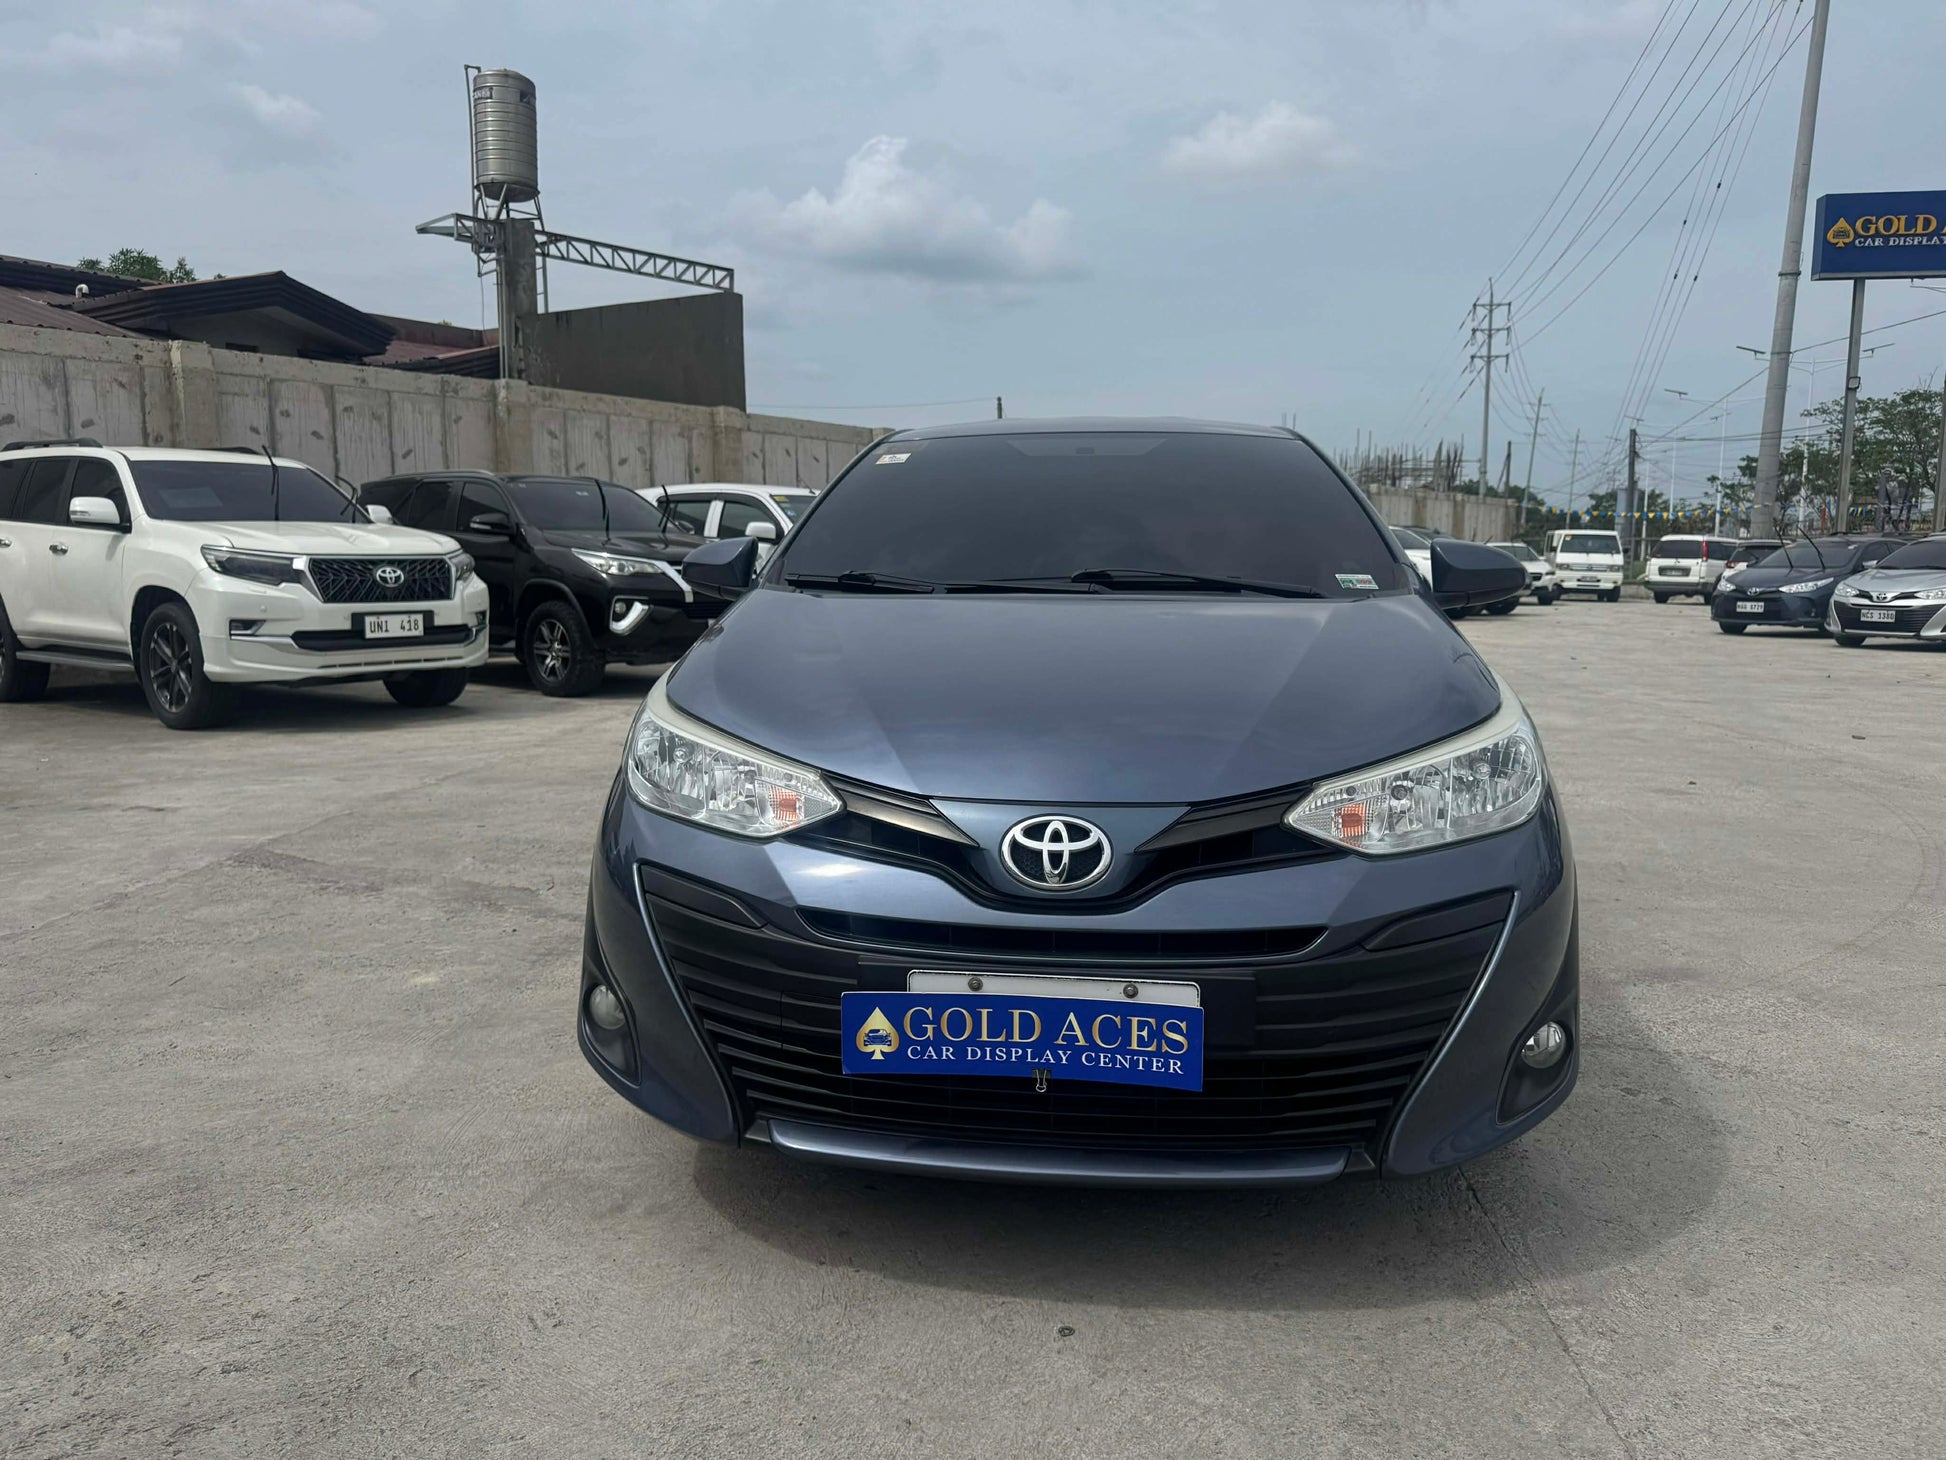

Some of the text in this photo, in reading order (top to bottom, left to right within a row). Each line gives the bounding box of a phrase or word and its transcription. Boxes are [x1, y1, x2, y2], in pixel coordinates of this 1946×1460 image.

[1855, 215, 1937, 236] GOLD
[1855, 237, 1884, 247] CAR
[369, 618, 420, 634] UNI 418
[903, 1006, 1189, 1055] GOLD ACES
[907, 1045, 1184, 1075] CAR DISPLAY CENTER
